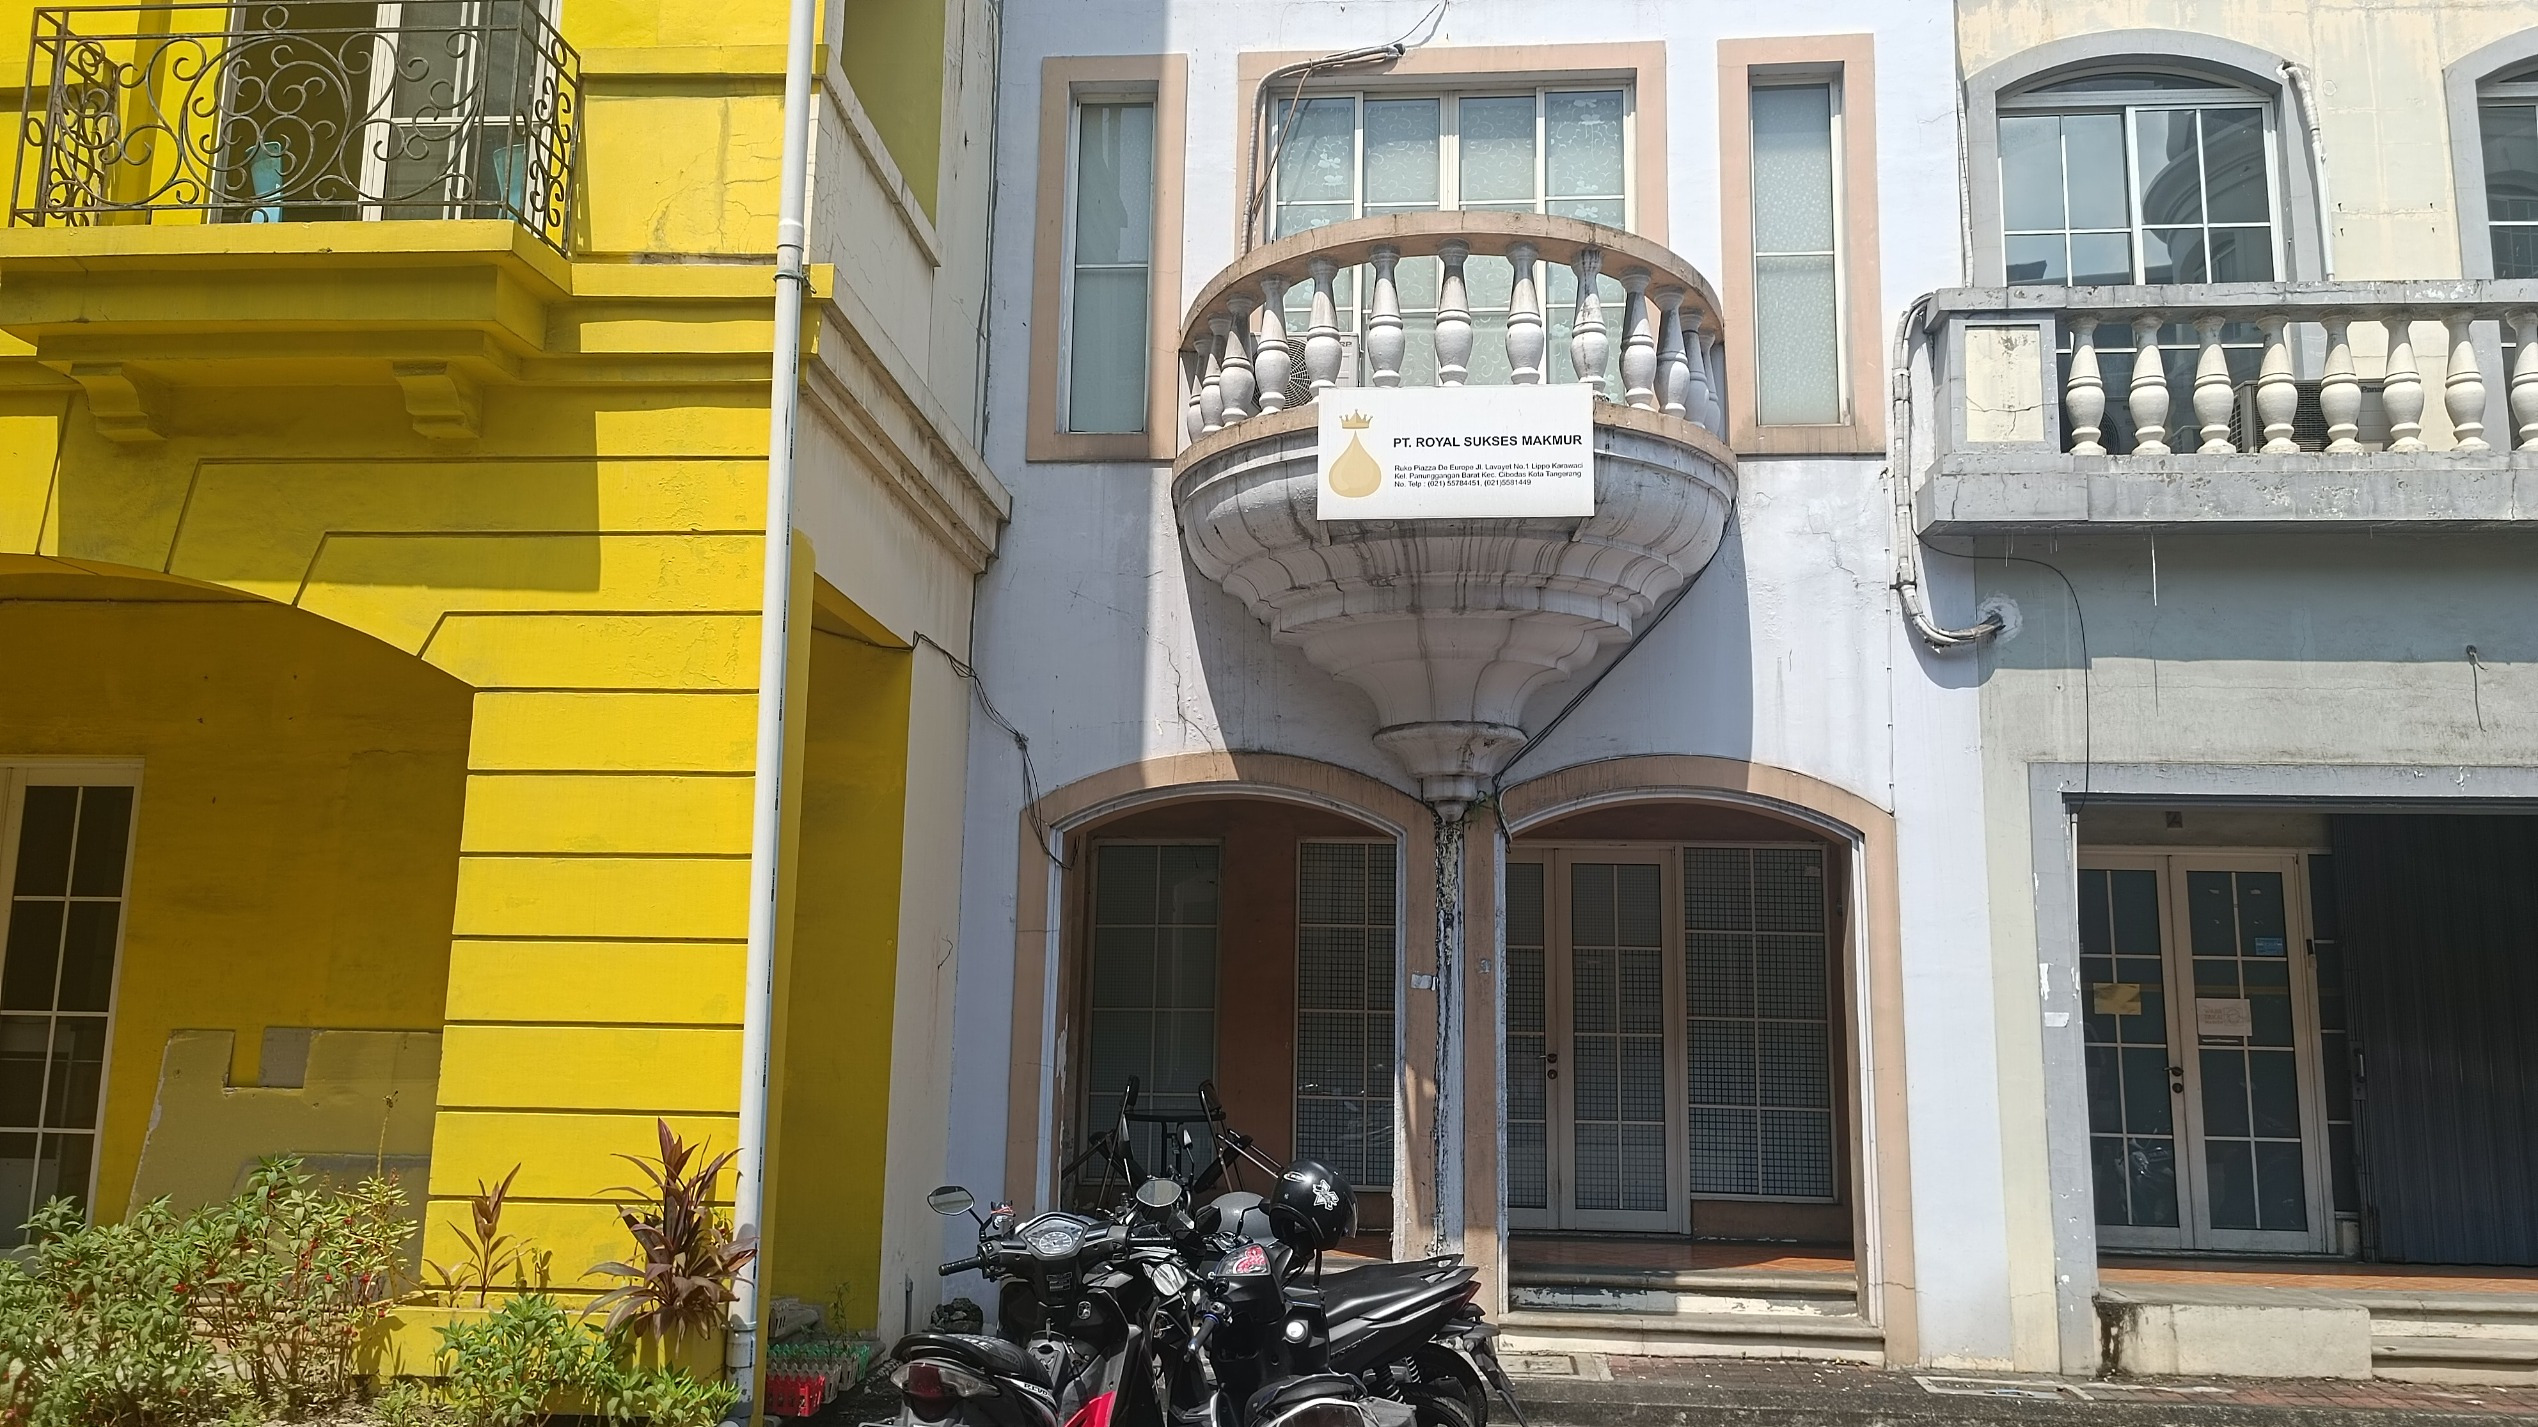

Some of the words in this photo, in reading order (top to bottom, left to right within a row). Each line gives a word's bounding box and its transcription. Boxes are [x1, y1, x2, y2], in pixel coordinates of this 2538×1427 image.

[1393, 437, 1412, 448] PT.
[1416, 436, 1460, 447] ROYAL
[1463, 436, 1518, 447] SUKSES
[1522, 434, 1583, 446] MAKMUR
[1449, 464, 1474, 472] Europe
[1409, 472, 1460, 480] Panunggangan
[1546, 470, 1582, 478] Tangerang
[1408, 480, 1422, 488] Telp
[1427, 480, 1446, 488] (021)
